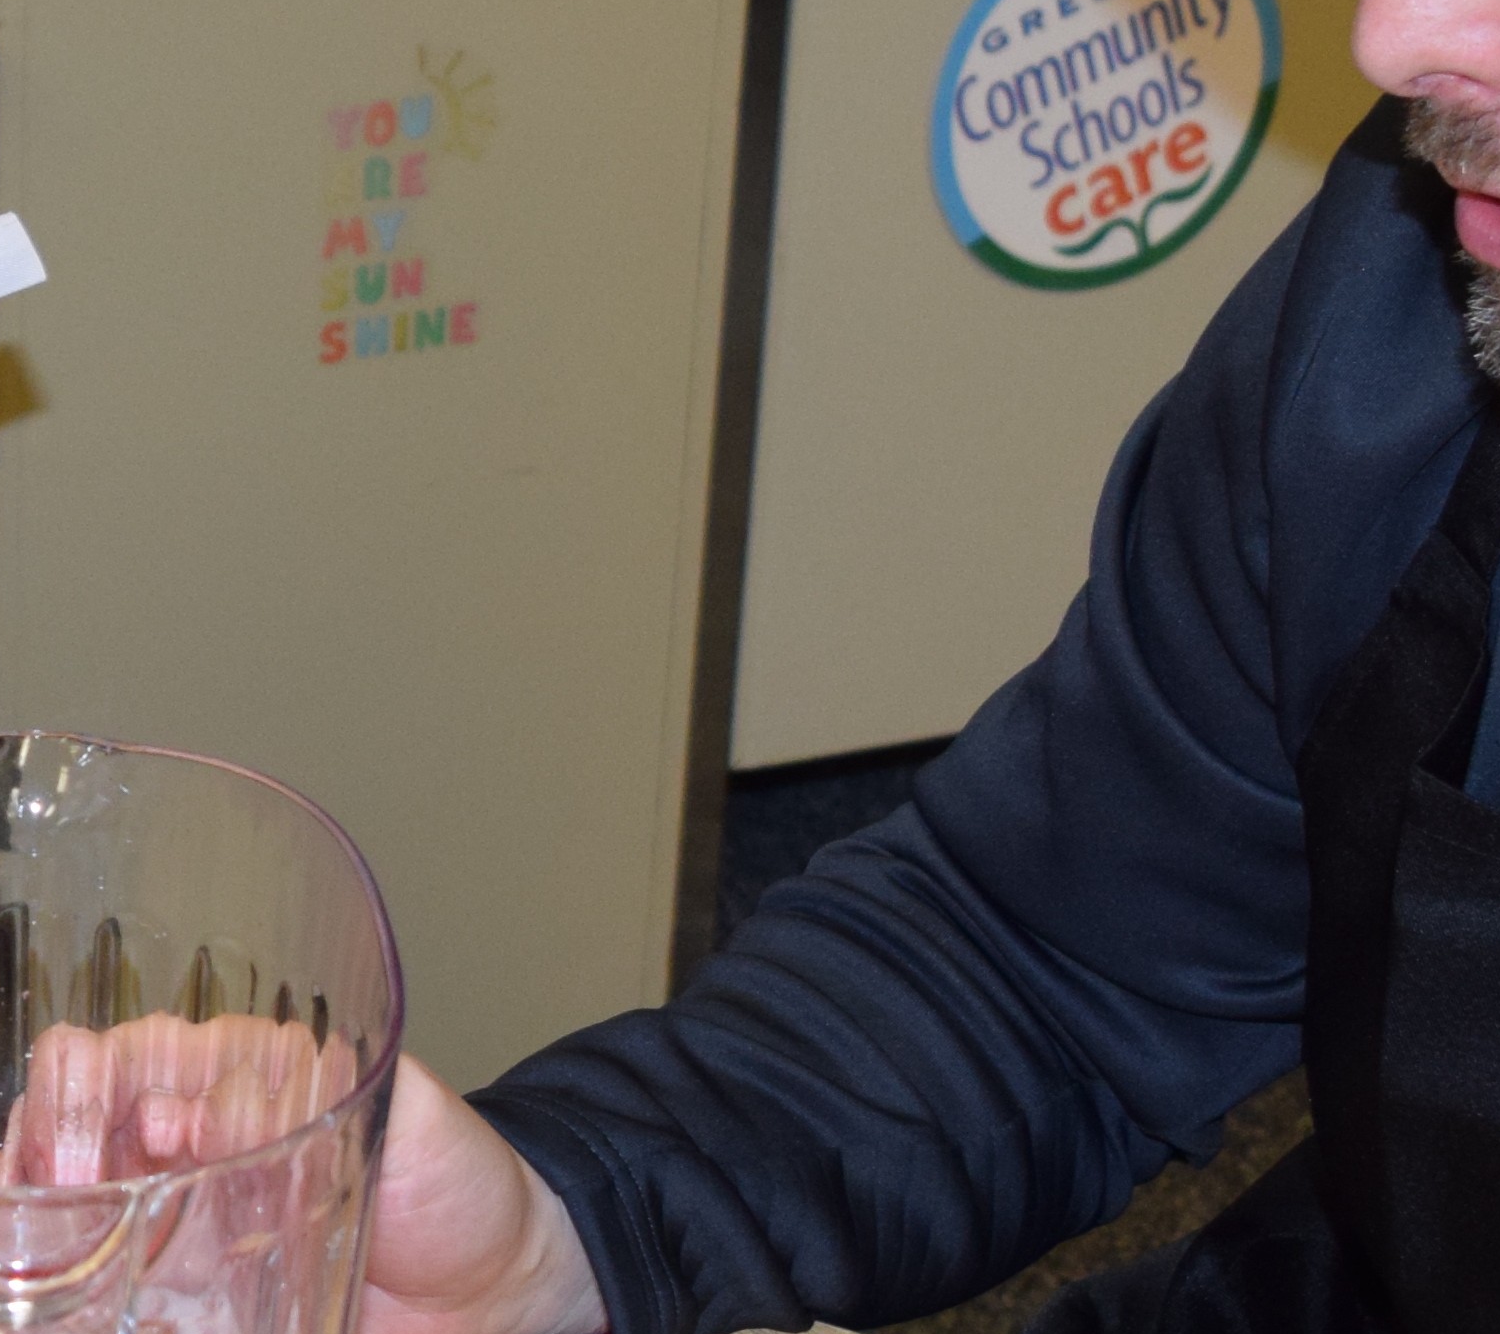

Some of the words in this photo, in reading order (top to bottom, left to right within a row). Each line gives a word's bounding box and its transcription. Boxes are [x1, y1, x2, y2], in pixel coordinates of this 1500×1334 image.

[328, 95, 433, 151] YOU
[1020, 53, 1205, 189] Schools
[1045, 121, 1208, 235] care
[322, 211, 407, 259] MY
[320, 256, 424, 311] SUN
[318, 301, 478, 364] SHINE
